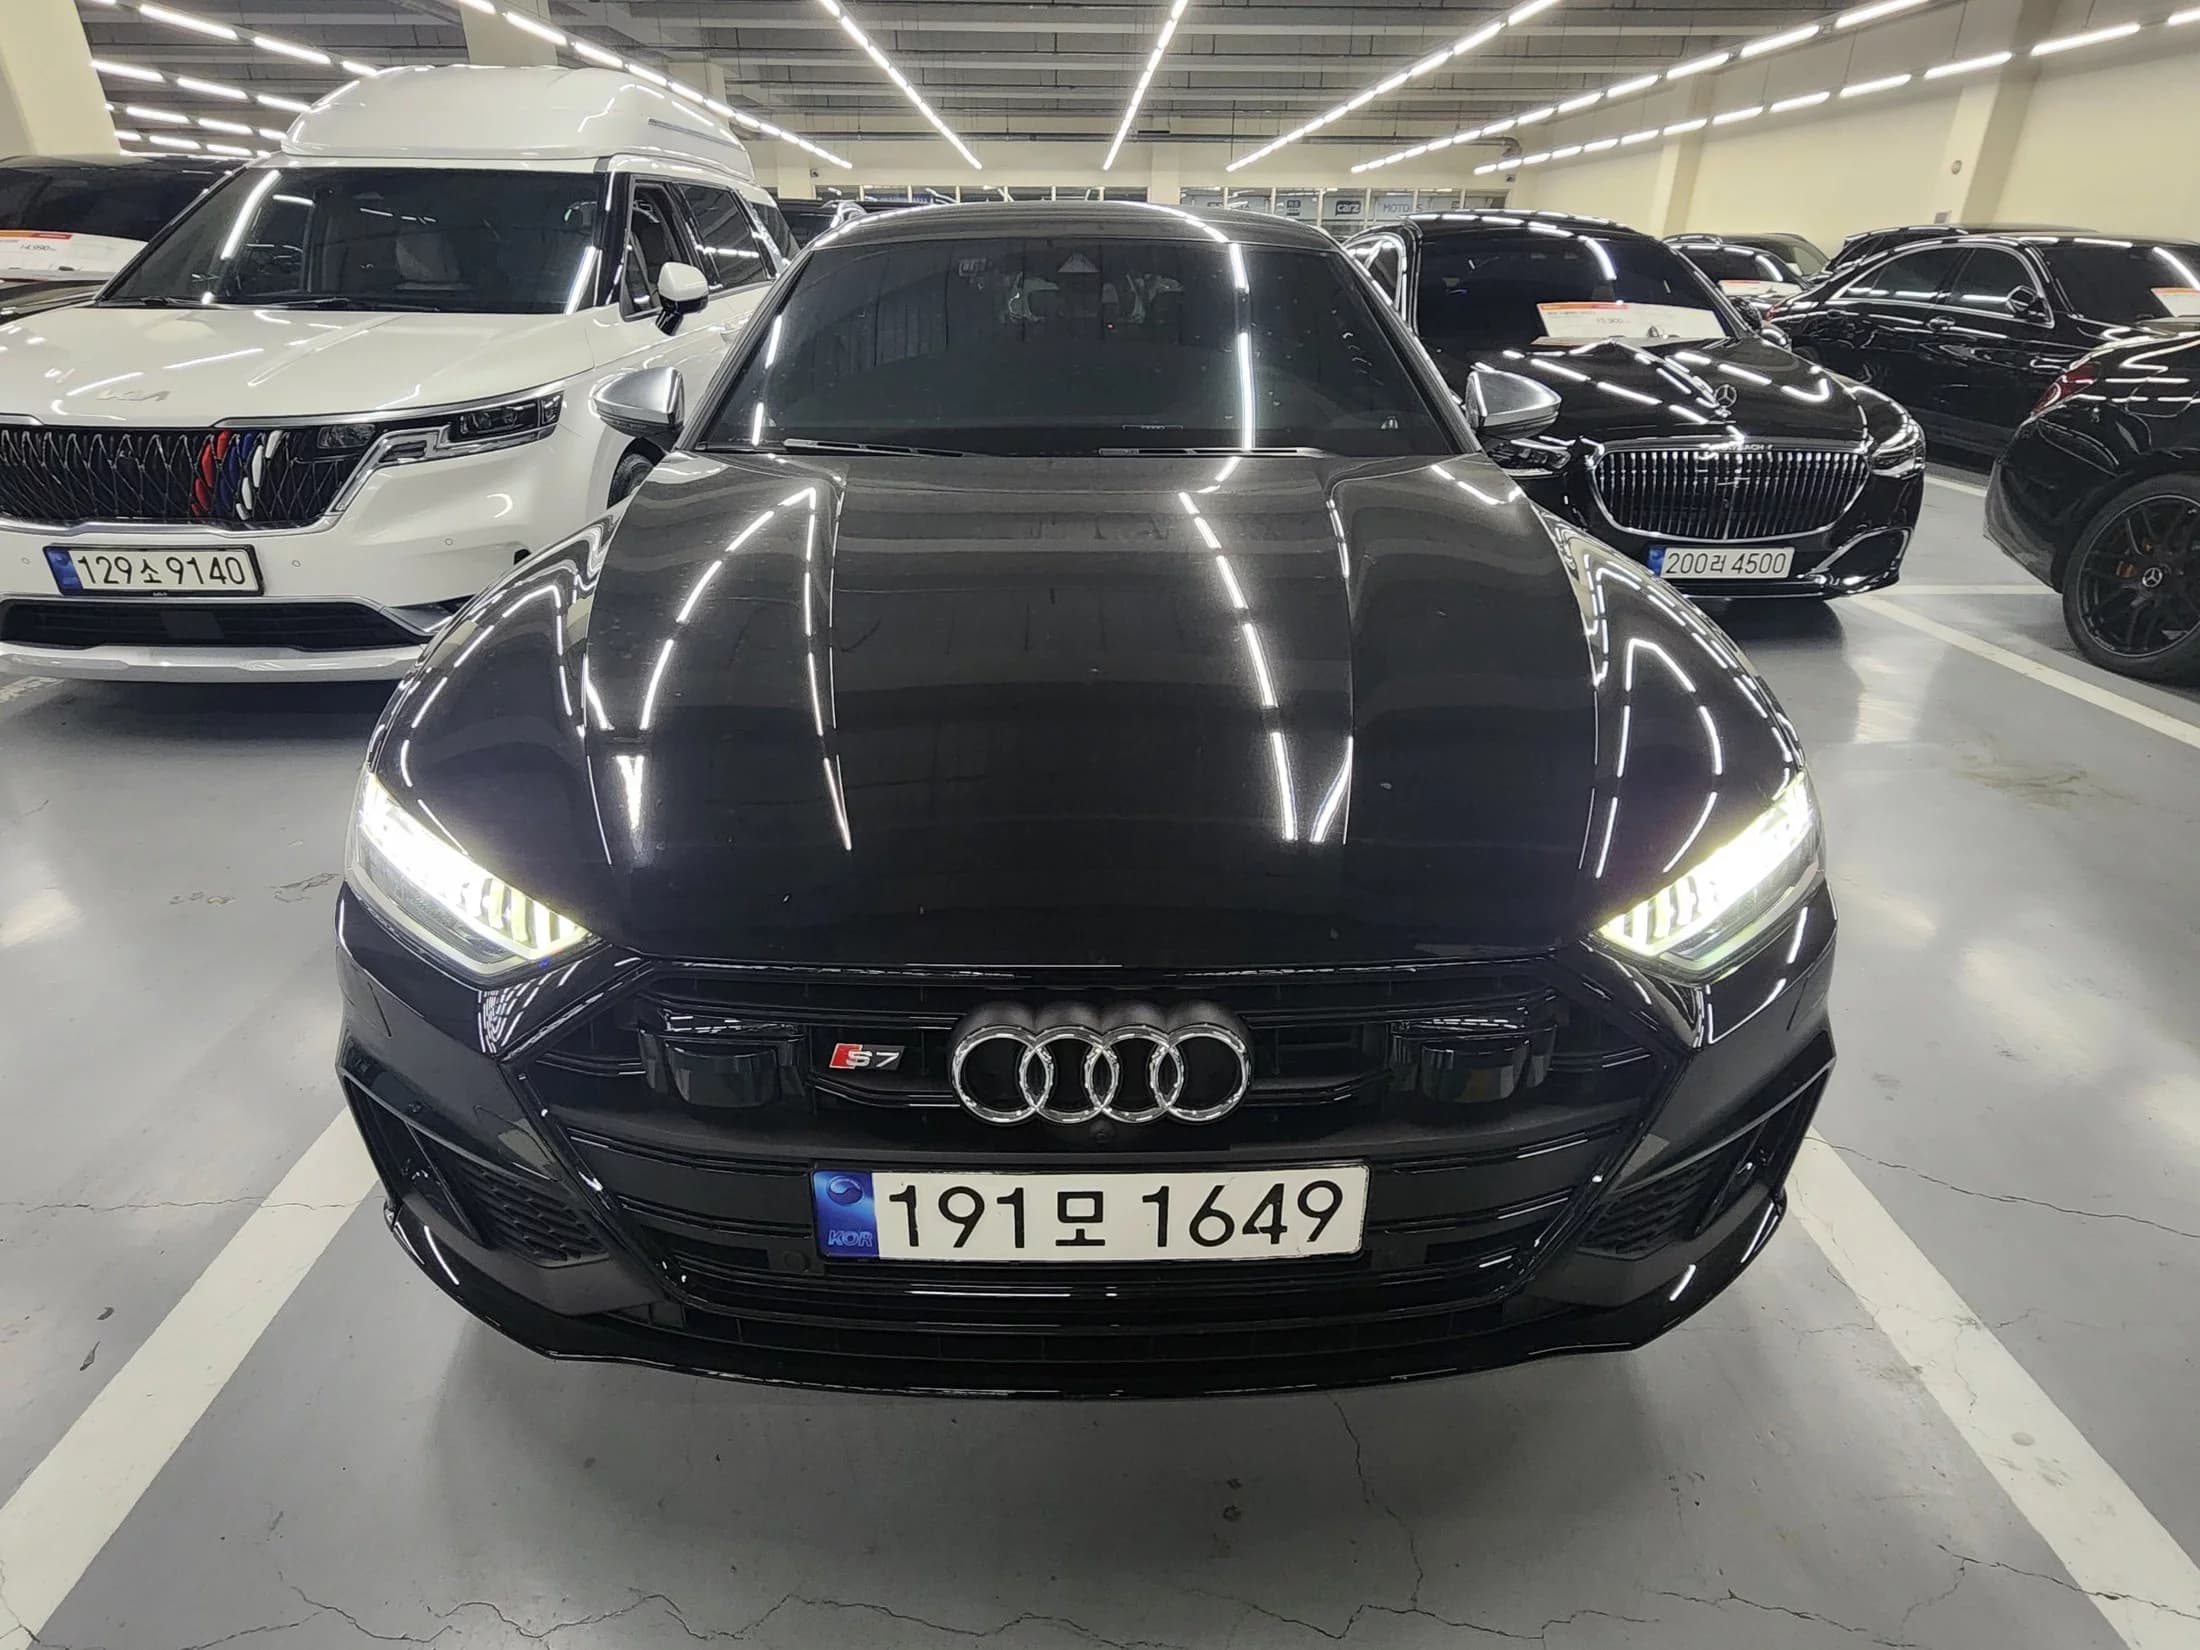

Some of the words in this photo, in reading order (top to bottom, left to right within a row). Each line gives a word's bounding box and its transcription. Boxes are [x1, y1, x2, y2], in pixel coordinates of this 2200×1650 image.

[1336, 201, 1361, 214] carz
[165, 556, 246, 585] 9140
[1731, 552, 1787, 574] 4500
[845, 1049, 901, 1069] S7
[889, 1184, 1106, 1249] 191모
[1142, 1179, 1344, 1248] 1649
[827, 1228, 873, 1248] KOR
